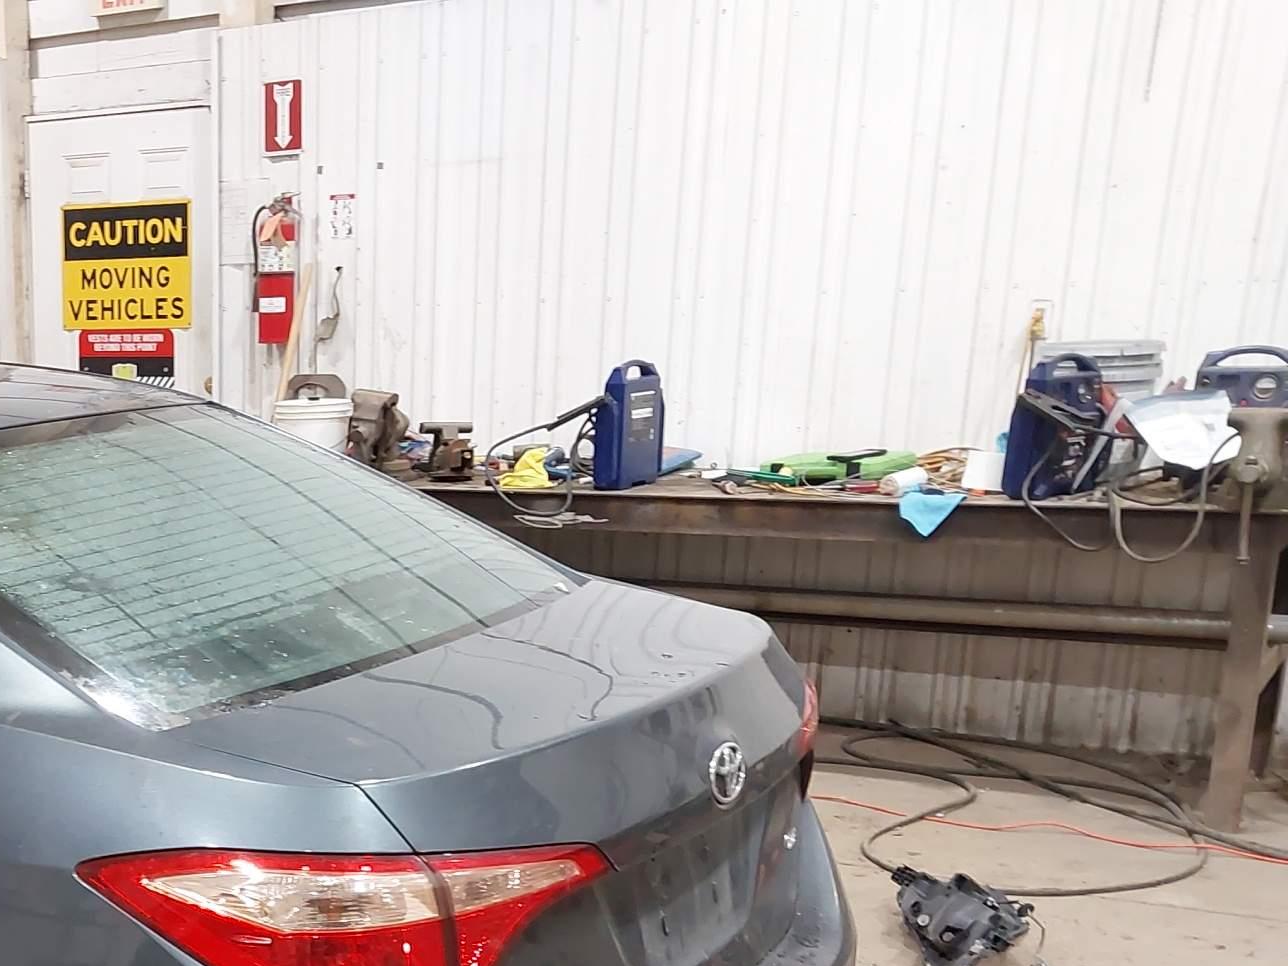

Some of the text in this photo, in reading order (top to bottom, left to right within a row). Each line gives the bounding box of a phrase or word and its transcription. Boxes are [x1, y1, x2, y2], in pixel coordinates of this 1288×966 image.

[69, 216, 183, 248] CAUTION
[80, 265, 170, 290] MOVING
[68, 297, 185, 321] VEHICLES
